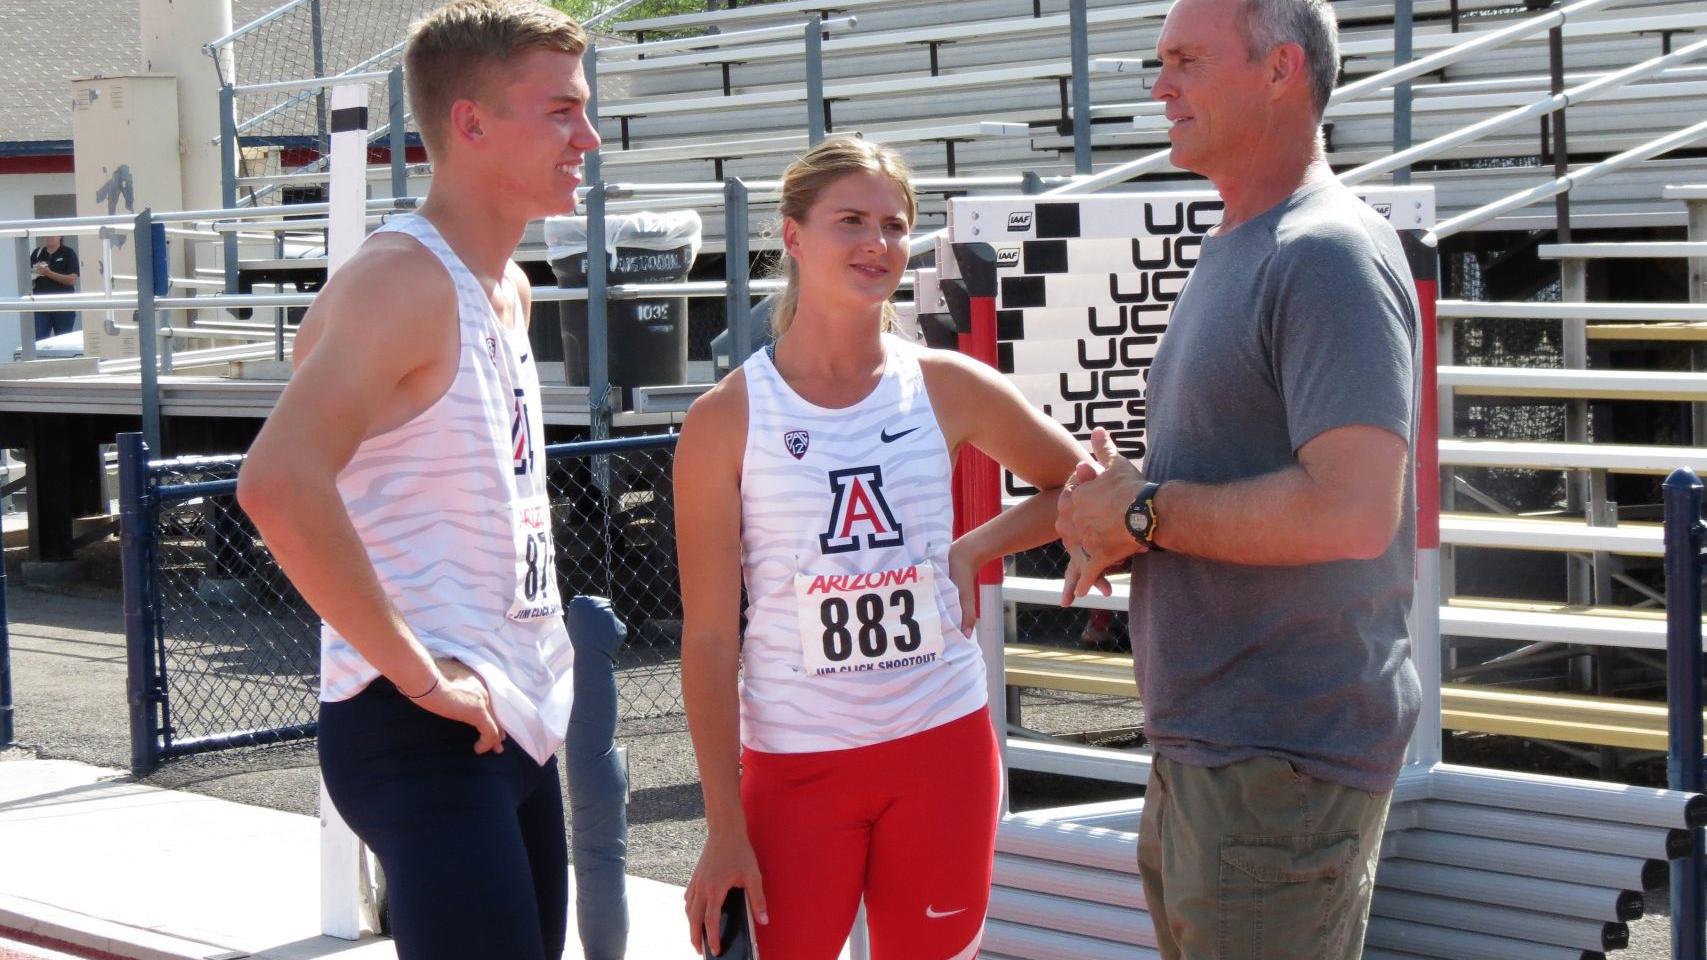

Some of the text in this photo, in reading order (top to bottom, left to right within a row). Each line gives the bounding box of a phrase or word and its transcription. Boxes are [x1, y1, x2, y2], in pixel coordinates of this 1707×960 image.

[1010, 201, 1225, 235] IAAF UC
[999, 235, 1203, 270] IAAF UC
[1110, 271, 1190, 303] UC
[1088, 304, 1169, 336] UC
[1078, 336, 1158, 369] UC
[1060, 369, 1150, 401] UC
[785, 431, 808, 449] PAC
[819, 465, 904, 554] A
[807, 565, 917, 594] ARIZONA
[820, 589, 921, 661] 883
[840, 663, 874, 673] CLICK
[878, 652, 937, 670] SHOOTOUT
